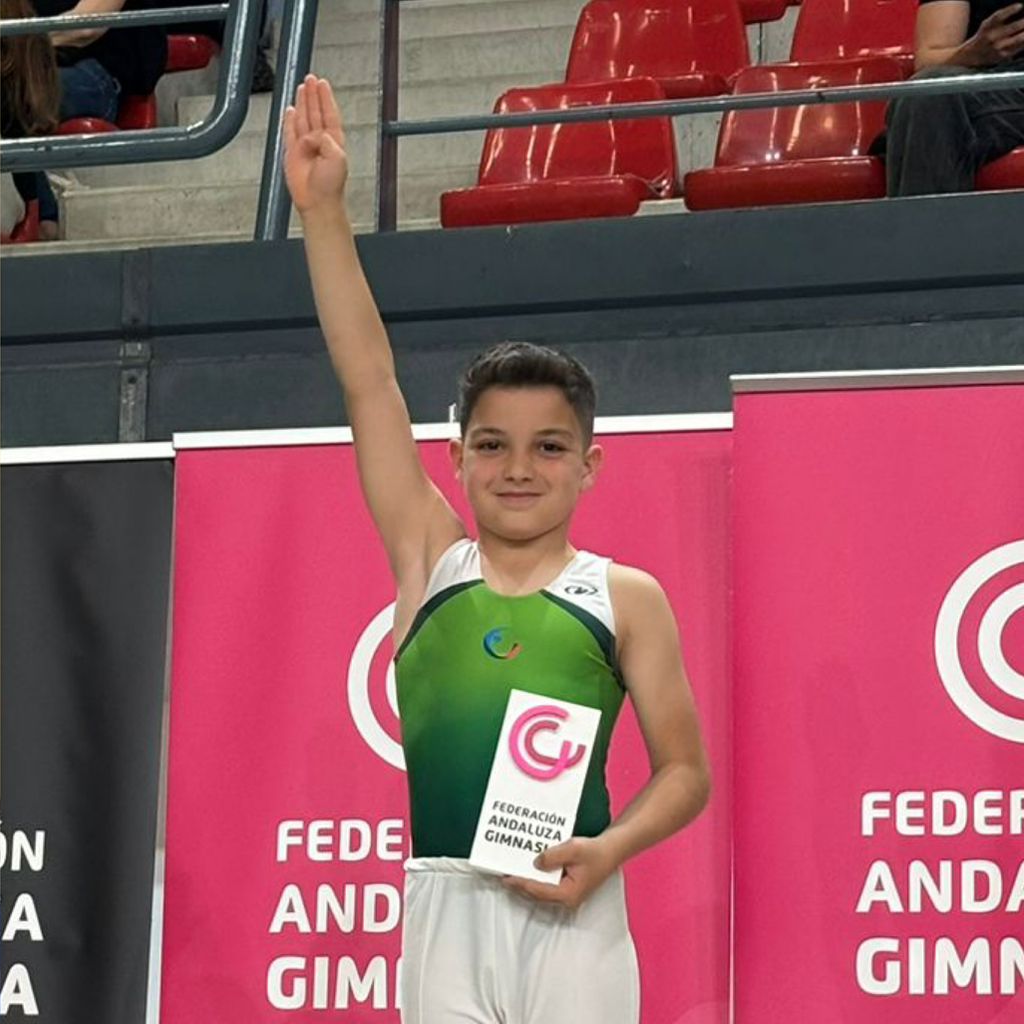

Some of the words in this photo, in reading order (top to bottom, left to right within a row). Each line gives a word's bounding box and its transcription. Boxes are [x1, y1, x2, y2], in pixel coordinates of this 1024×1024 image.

[488, 815, 562, 841] ANDALUZA
[492, 801, 566, 826] FEDERACIÓN
[0, 830, 46, 872] N
[267, 955, 402, 1010] GIM
